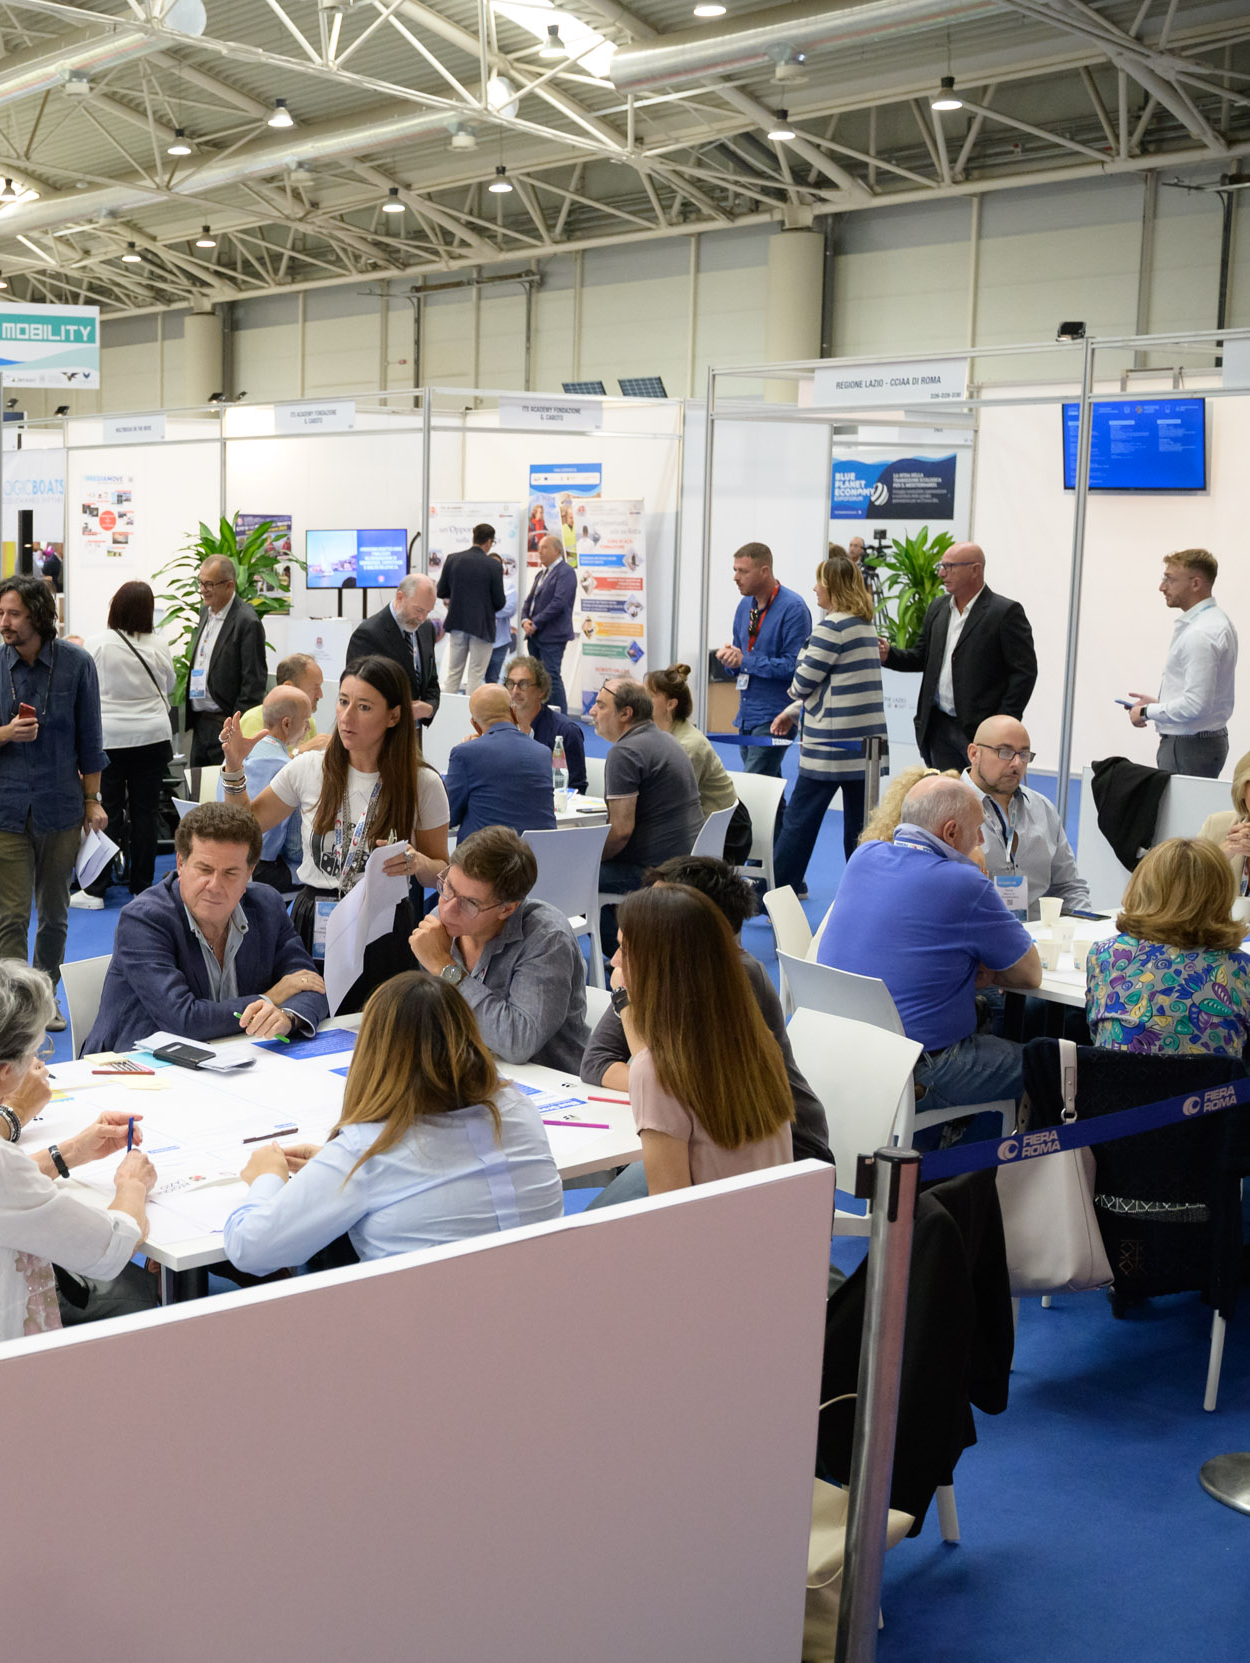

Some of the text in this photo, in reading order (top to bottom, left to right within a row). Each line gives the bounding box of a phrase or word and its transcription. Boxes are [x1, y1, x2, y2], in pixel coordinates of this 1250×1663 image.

[2, 322, 92, 341] MOBILITY
[836, 379, 863, 390] REGIONE
[865, 379, 884, 389] LAZIO
[890, 377, 911, 387] CCIAA
[912, 376, 919, 385] DI
[920, 376, 941, 385] ROMA
[530, 406, 553, 414] ACADEMY
[553, 407, 581, 415] FONDAZIONE
[835, 472, 856, 481] BLUE
[835, 480, 866, 488] PLANET
[835, 488, 874, 497] ECONOMY
[1204, 1085, 1235, 1102] FIERA
[1203, 1095, 1238, 1113] ROMA
[1023, 1130, 1059, 1146] FIERA
[1021, 1140, 1061, 1159] ROMA
